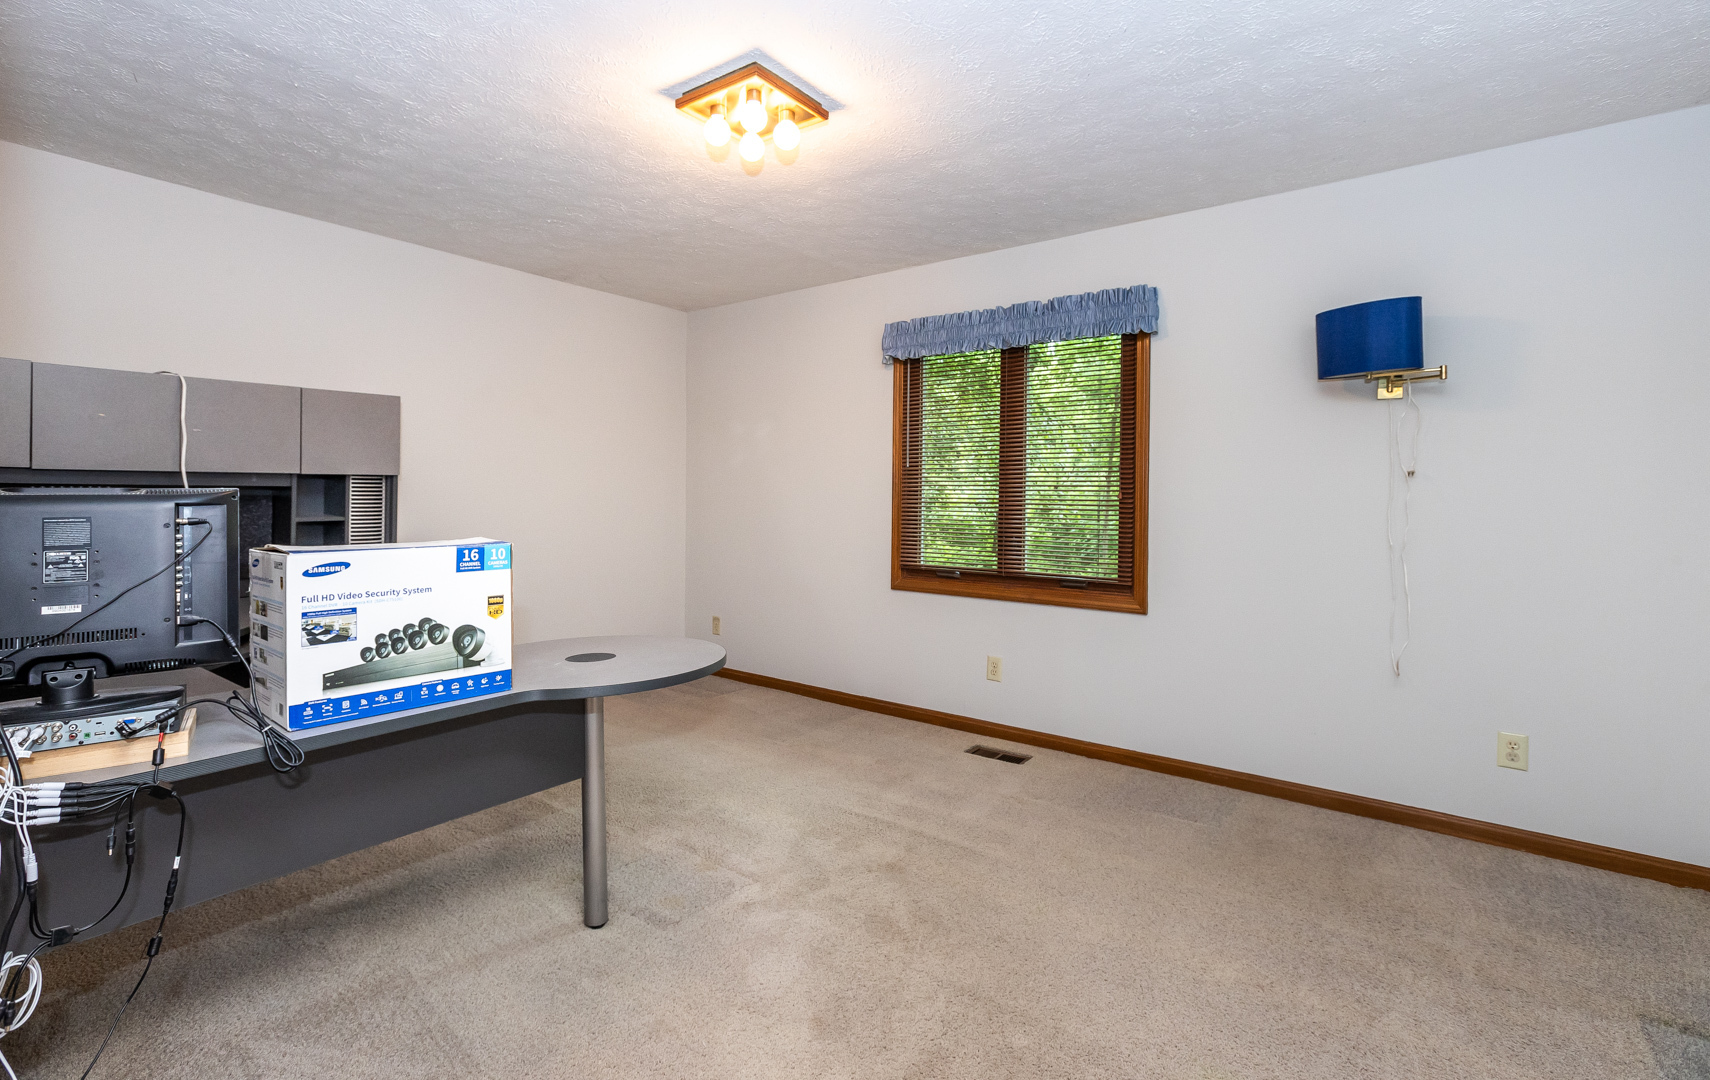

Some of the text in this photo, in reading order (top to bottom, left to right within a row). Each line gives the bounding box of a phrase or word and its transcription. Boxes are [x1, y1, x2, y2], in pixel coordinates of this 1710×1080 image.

[462, 549, 479, 561] 16
[490, 548, 506, 560] 10
[307, 565, 346, 574] SAMSUNG
[301, 586, 433, 604] Full HD Video Security System
